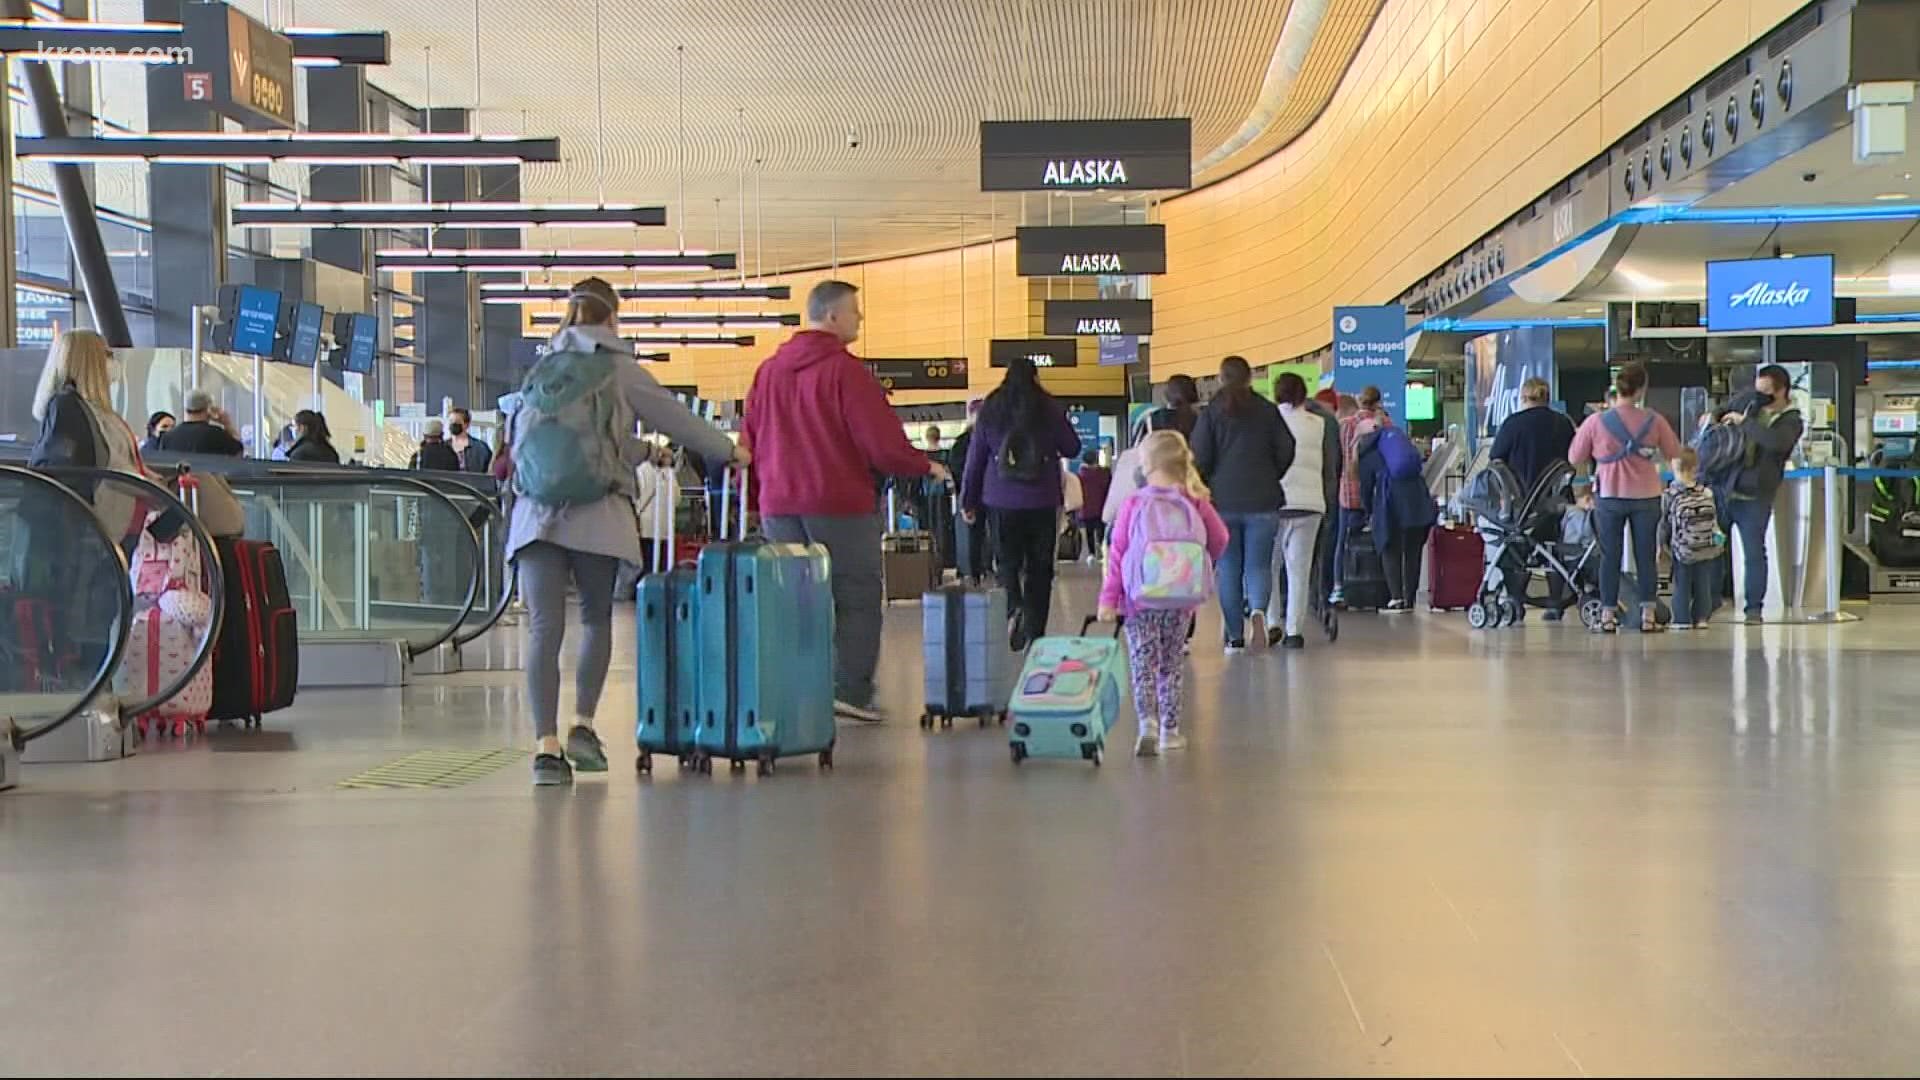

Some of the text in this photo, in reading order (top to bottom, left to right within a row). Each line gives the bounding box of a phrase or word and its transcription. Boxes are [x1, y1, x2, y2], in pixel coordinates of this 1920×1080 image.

[191, 79, 205, 100] 5
[1043, 159, 1127, 184] ALASKA
[1061, 254, 1121, 272] ALASKA
[1729, 281, 1810, 308] Alaska
[1077, 319, 1121, 334] ALASKA
[1339, 341, 1405, 353] Drop tagged
[1339, 356, 1393, 368] bags here.
